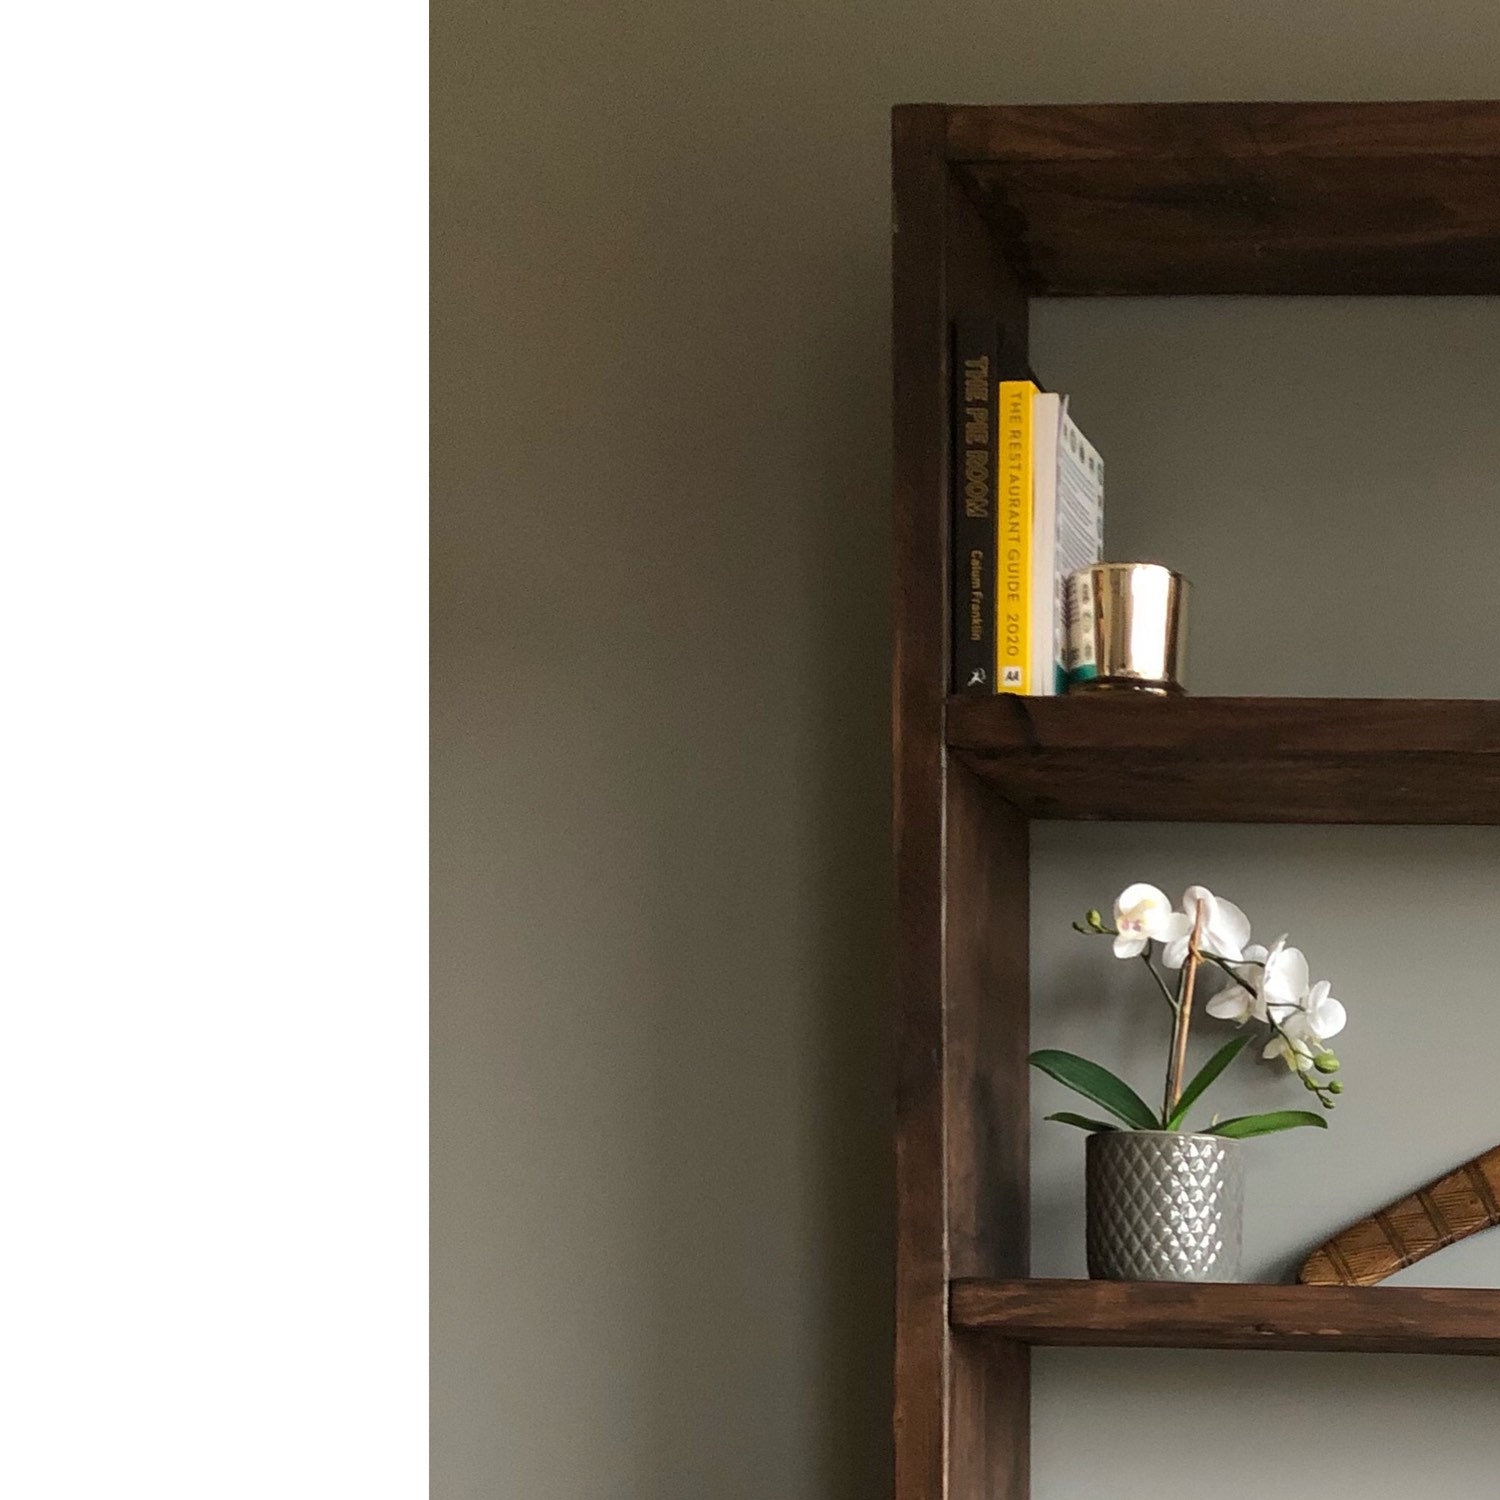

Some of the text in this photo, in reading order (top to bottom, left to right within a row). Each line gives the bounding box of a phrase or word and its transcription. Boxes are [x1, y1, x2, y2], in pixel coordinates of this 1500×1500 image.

[965, 356, 989, 518] THE PIE ROOM
[1007, 392, 1022, 657] THE RESTAURANT GUIDE 2020
